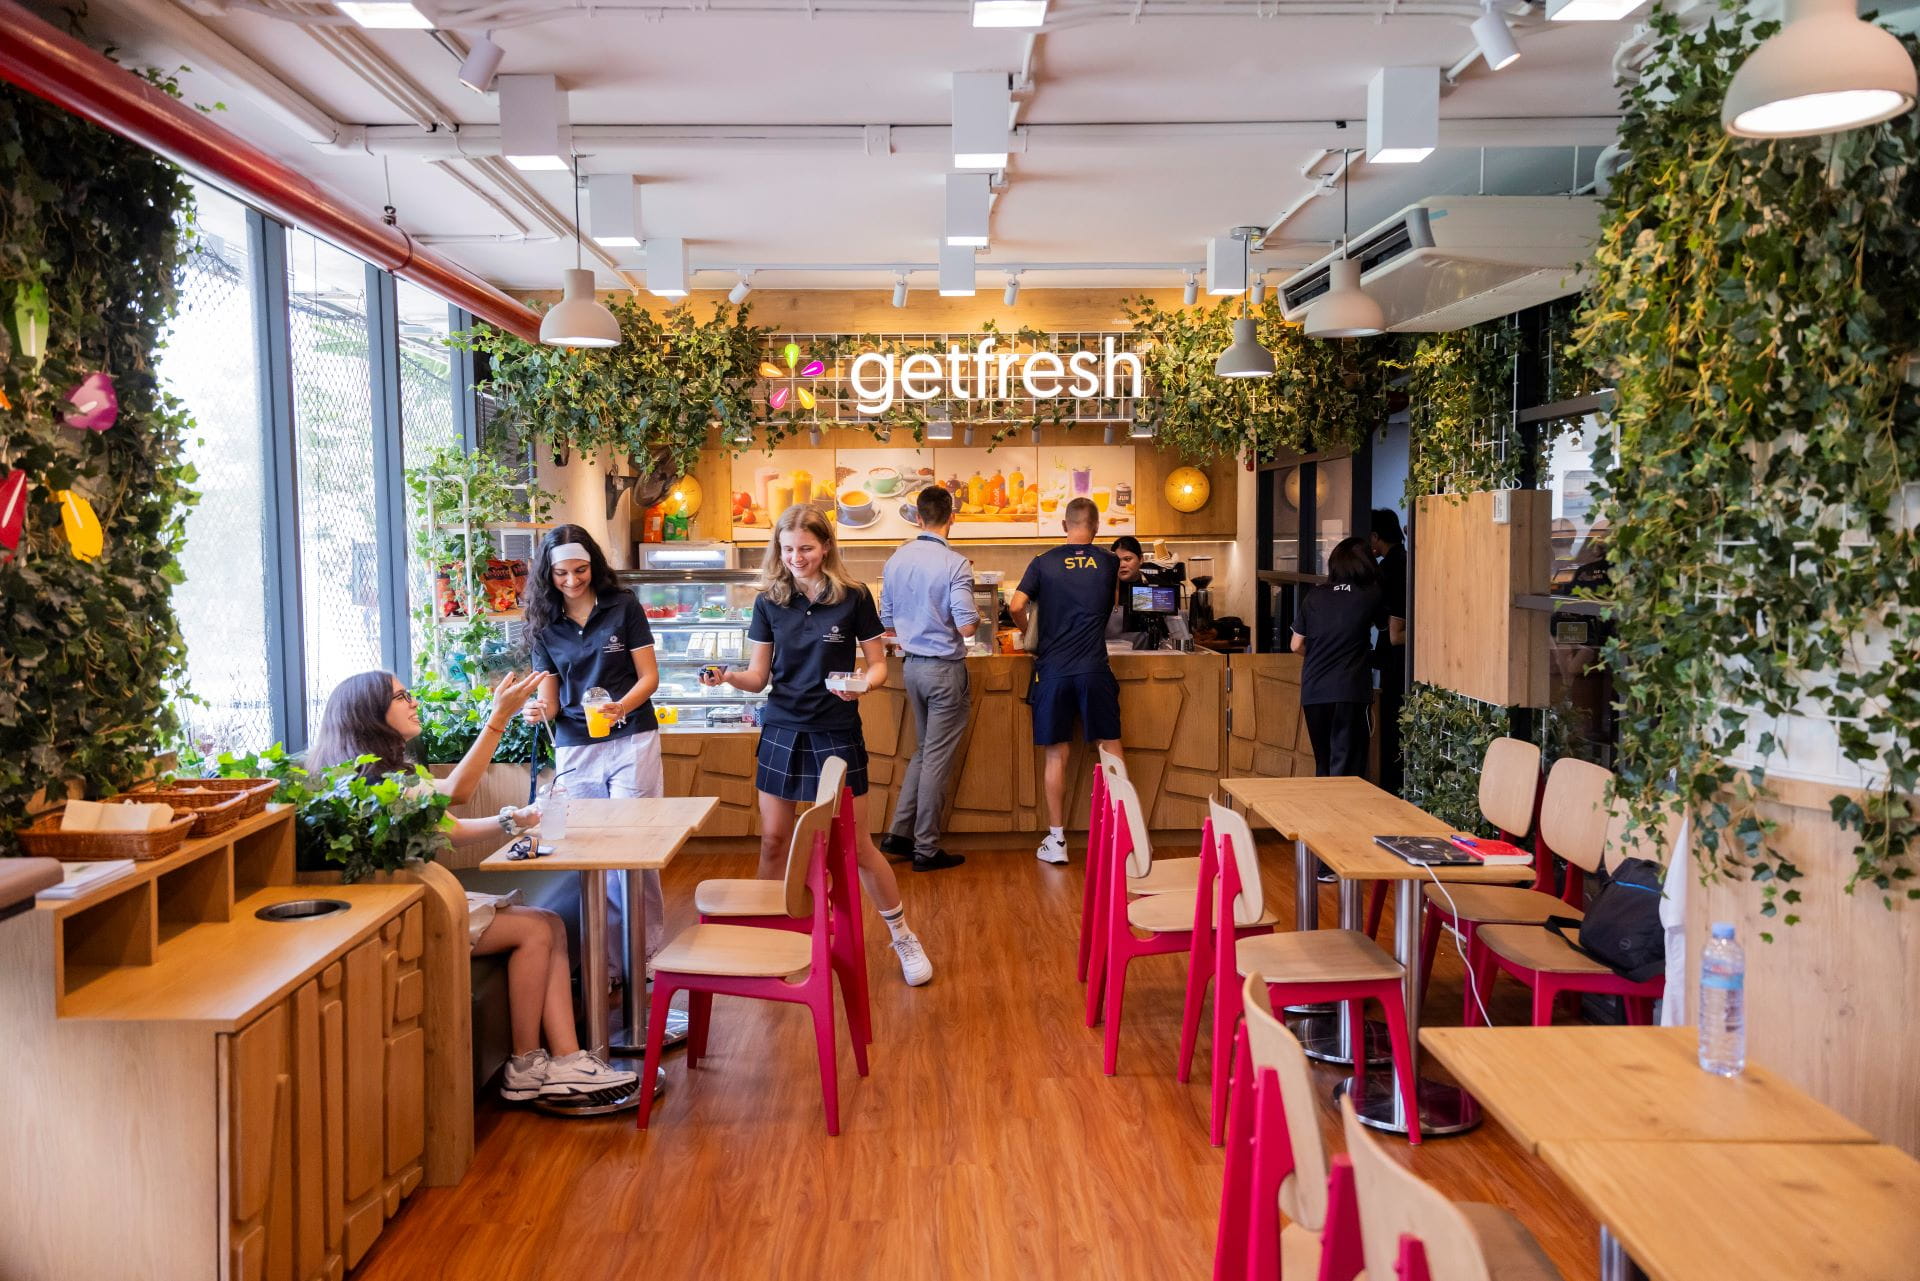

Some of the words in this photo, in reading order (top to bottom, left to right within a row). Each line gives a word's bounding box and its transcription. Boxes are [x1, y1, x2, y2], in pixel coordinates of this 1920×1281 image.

[850, 337, 1142, 414] getfresh
[1064, 556, 1098, 570] STA
[1333, 583, 1351, 592] STA
